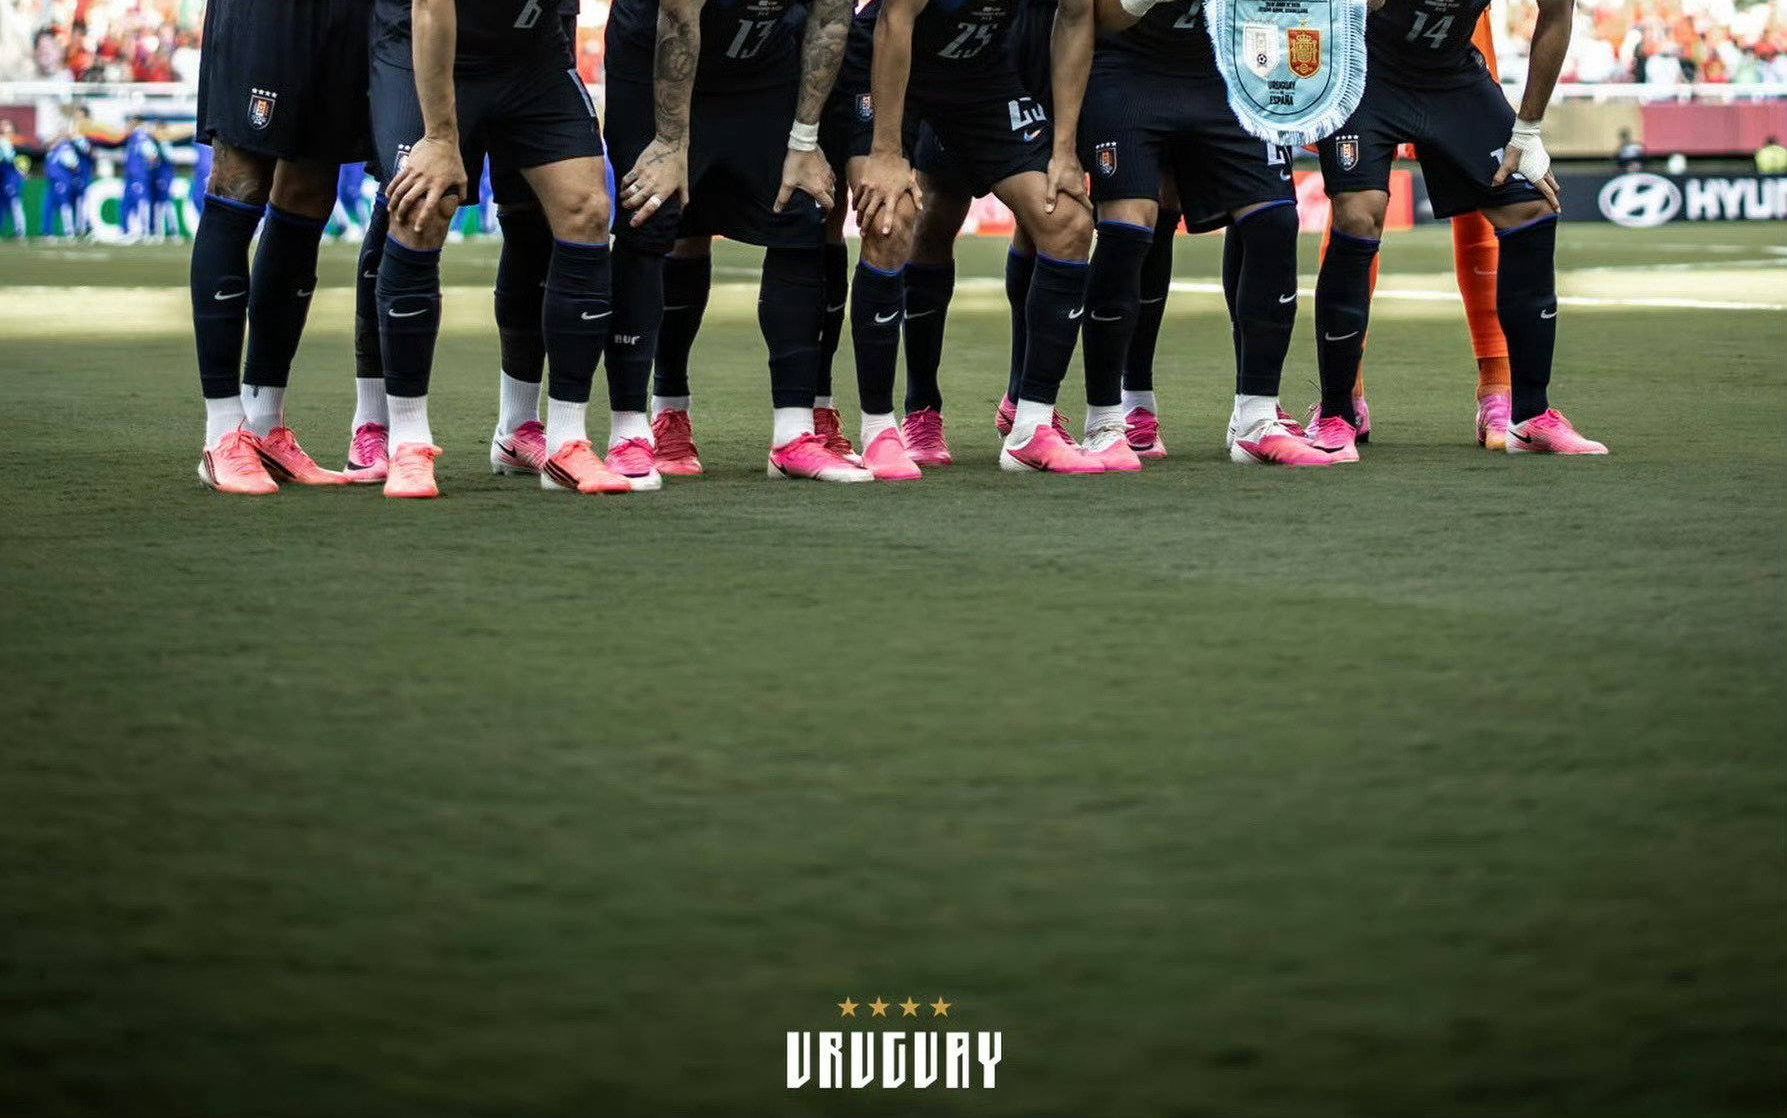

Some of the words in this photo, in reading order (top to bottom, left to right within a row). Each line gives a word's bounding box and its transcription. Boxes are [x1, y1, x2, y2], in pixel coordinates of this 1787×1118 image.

[726, 18, 777, 59] 13
[938, 22, 1000, 59] 25
[1405, 11, 1455, 49] 14
[1268, 80, 1296, 90] URUGUAY
[1269, 94, 1294, 106] ESPAÑA
